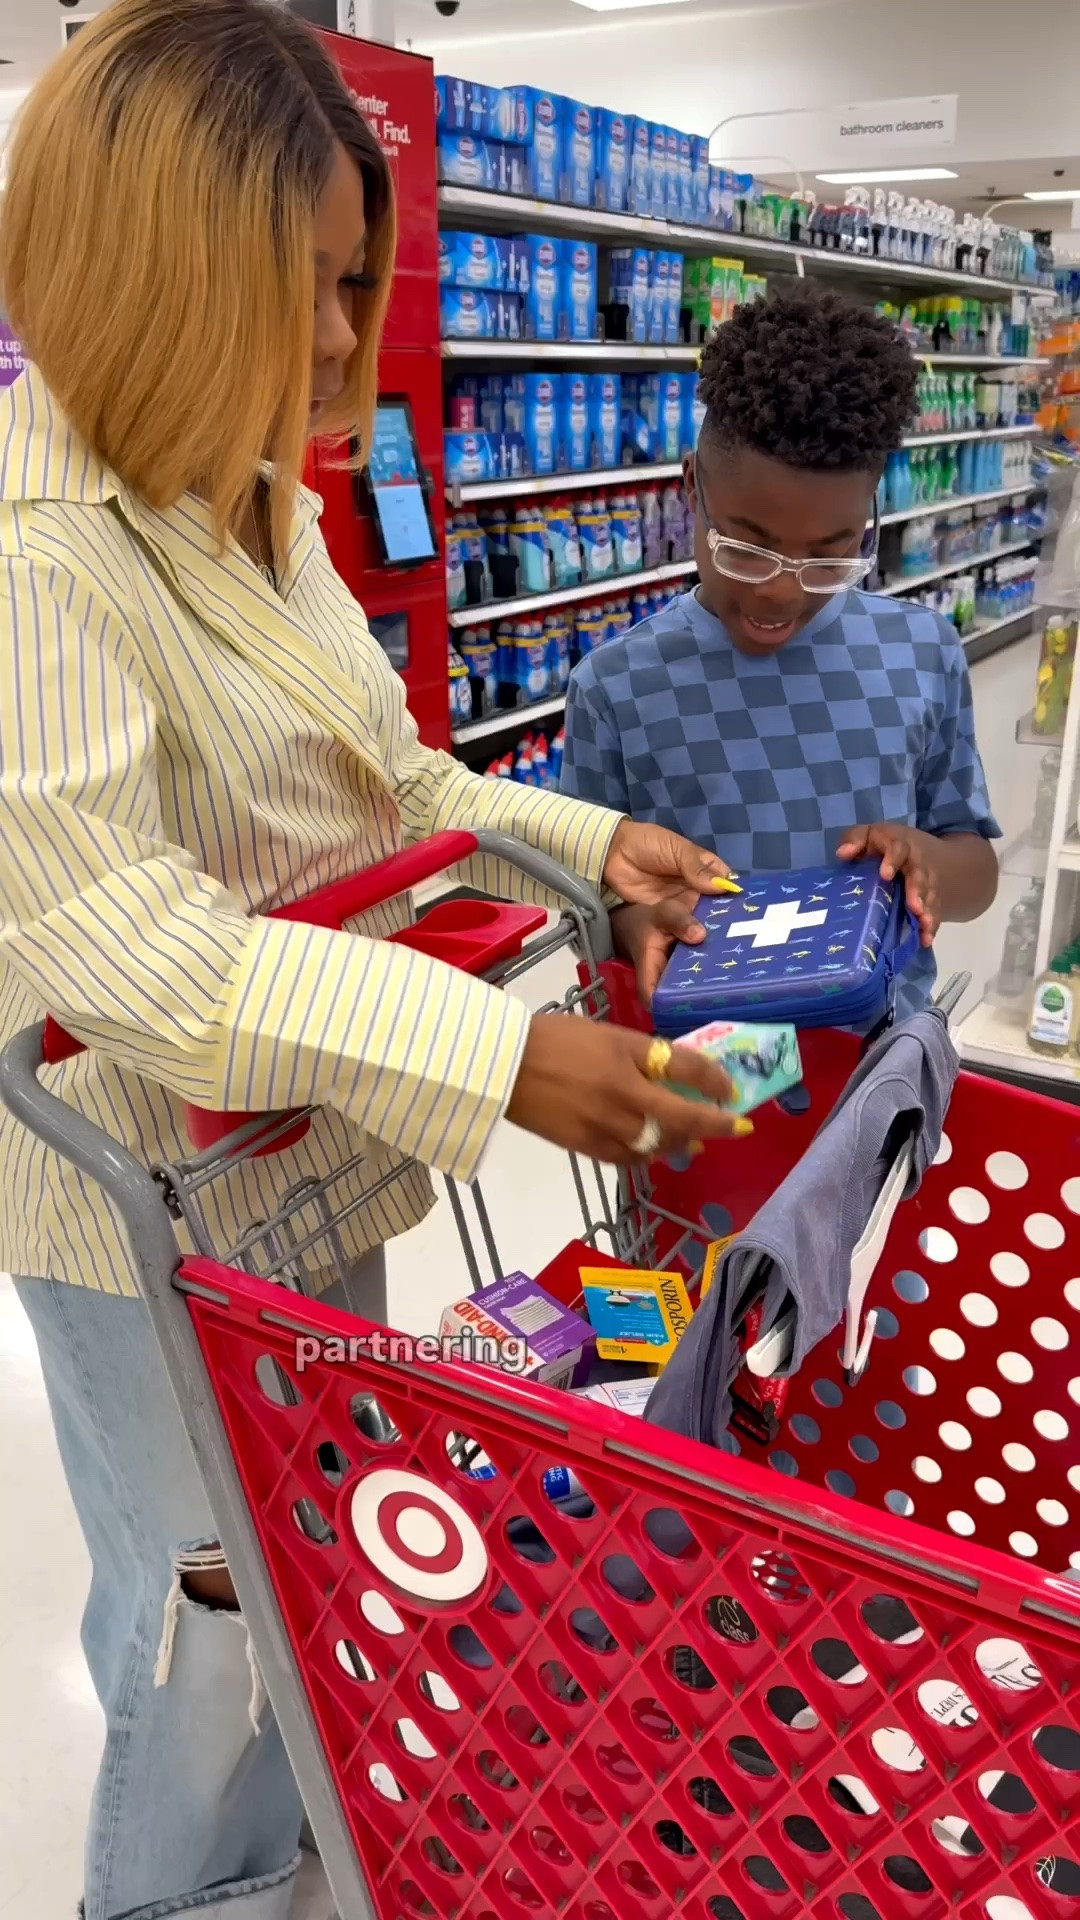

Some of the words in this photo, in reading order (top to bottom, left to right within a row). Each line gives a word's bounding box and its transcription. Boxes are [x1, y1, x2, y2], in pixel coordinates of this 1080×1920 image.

[383, 120, 411, 144] Find.
[840, 124, 893, 136] bathroom
[896, 119, 944, 132] cleaners
[659, 1277, 688, 1342] OSPORIN
[931, 1696, 959, 1718] DEPT.
